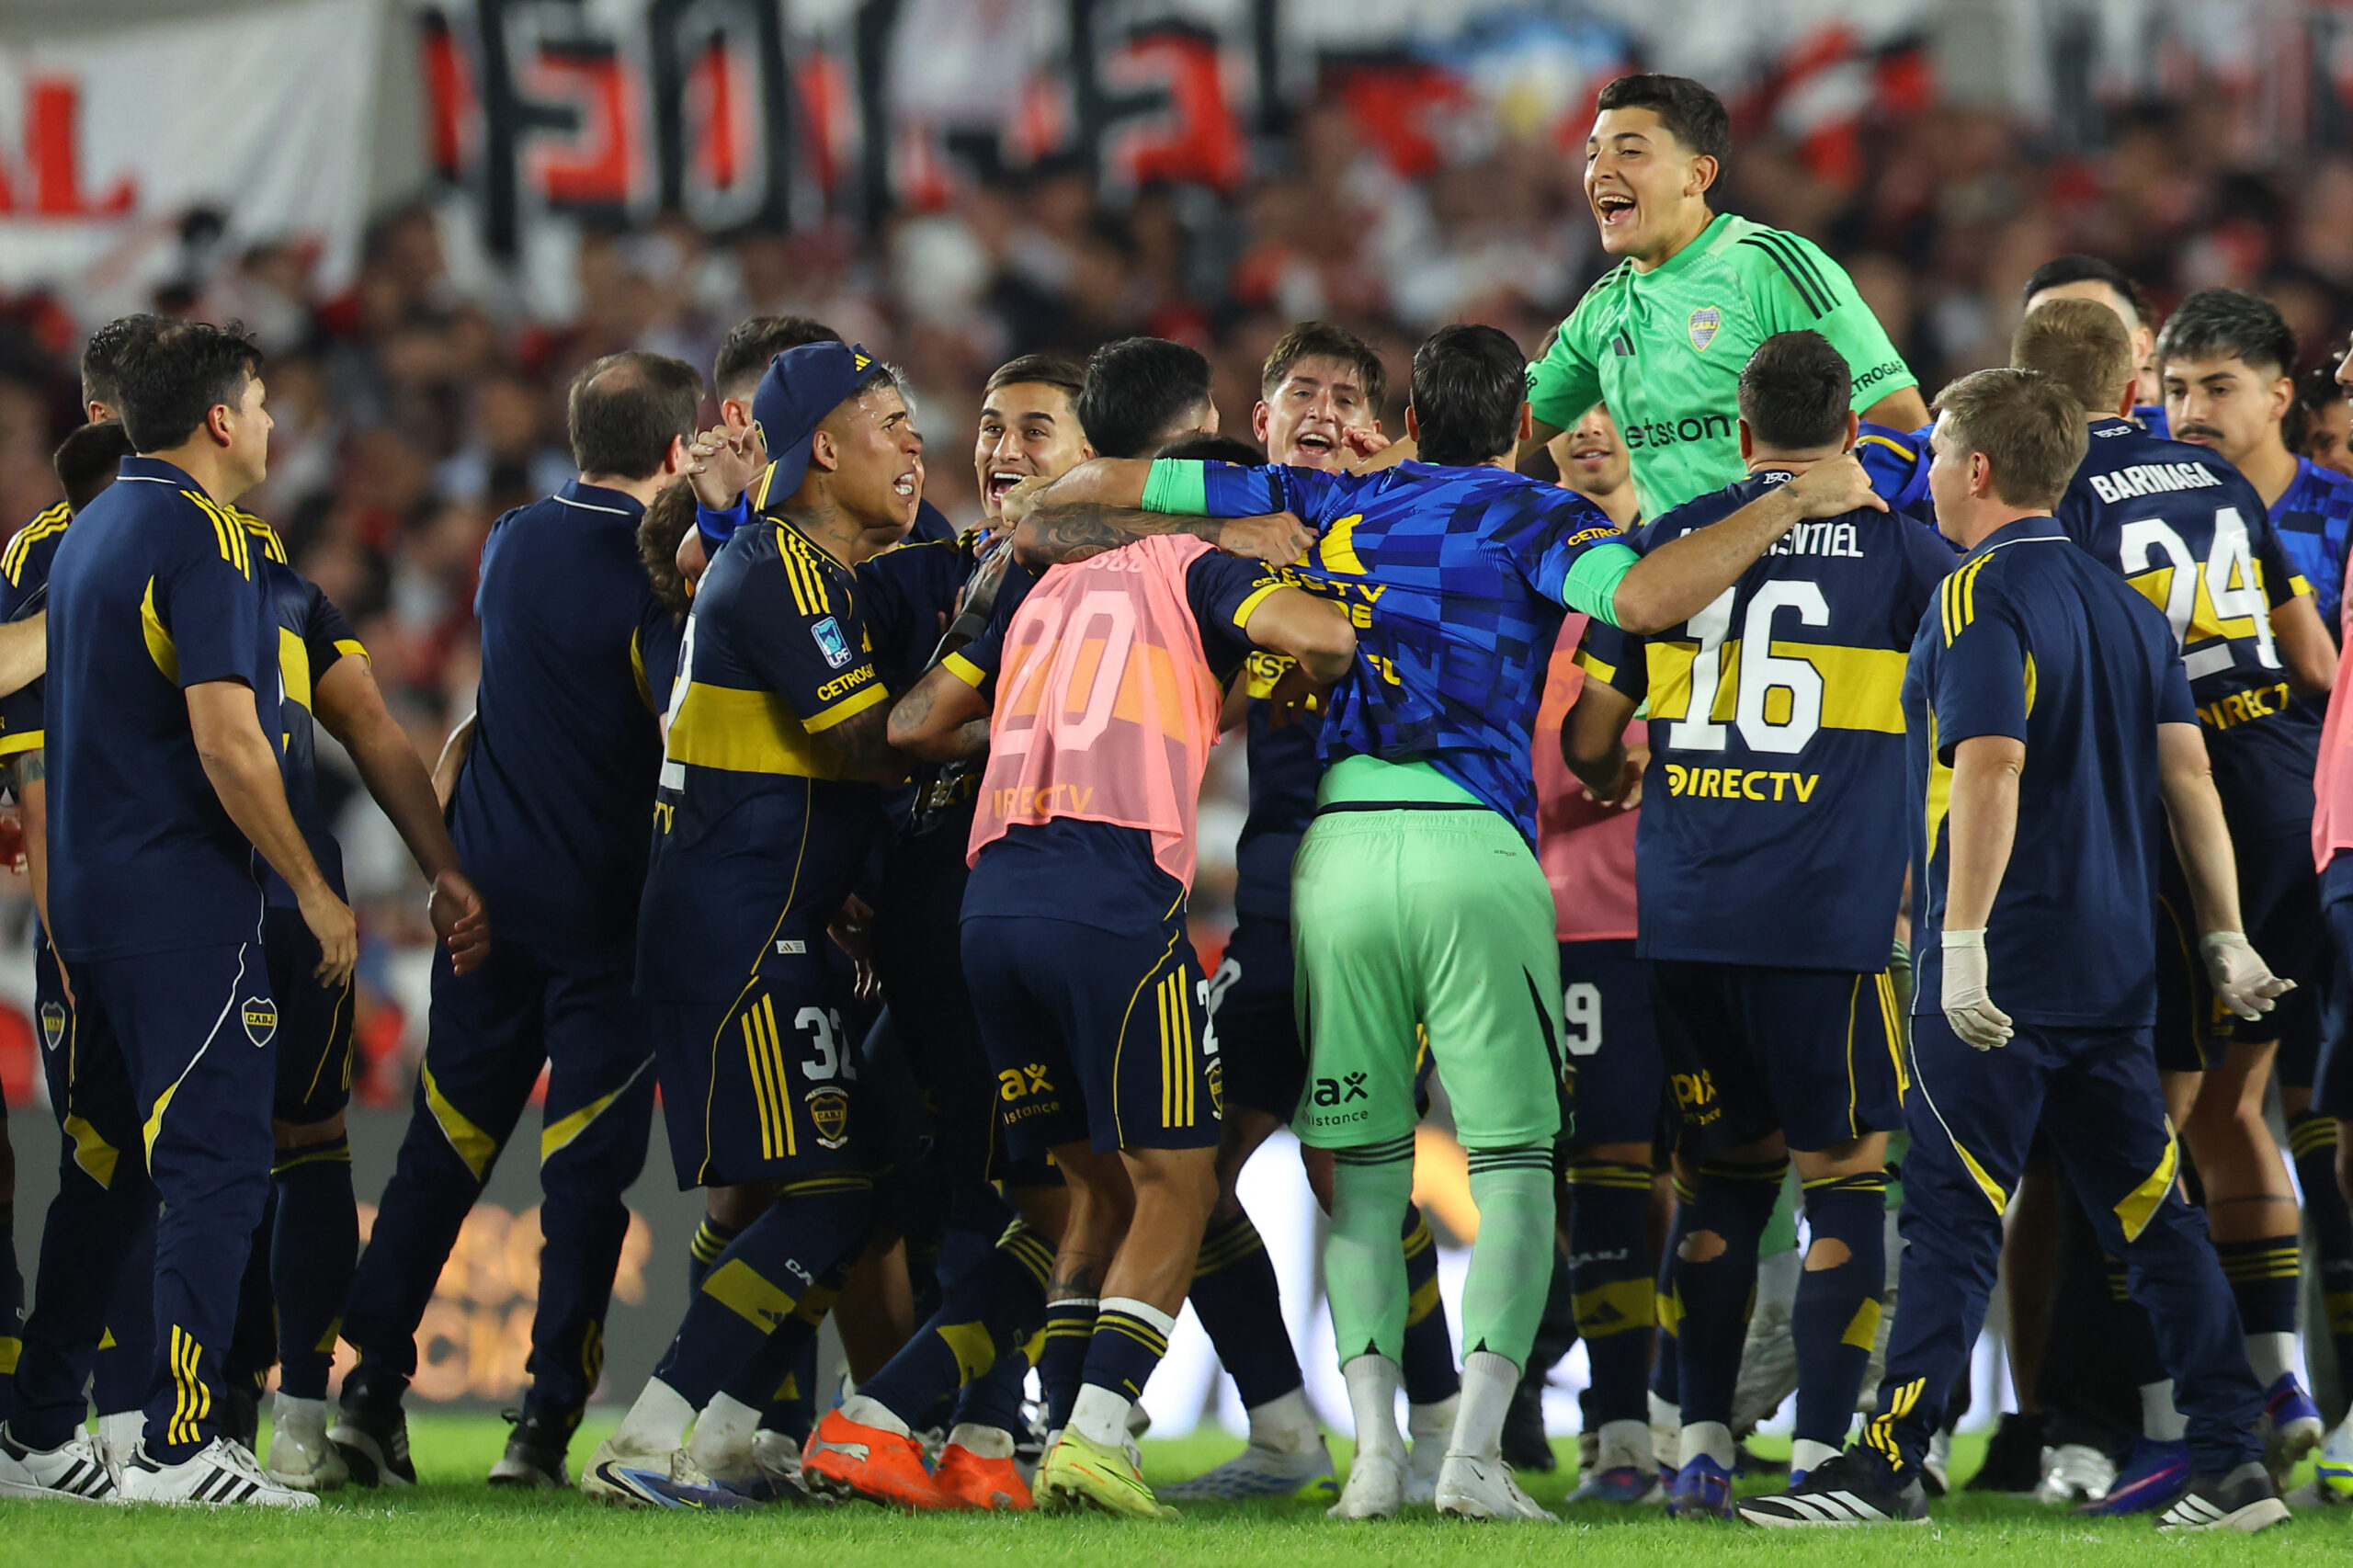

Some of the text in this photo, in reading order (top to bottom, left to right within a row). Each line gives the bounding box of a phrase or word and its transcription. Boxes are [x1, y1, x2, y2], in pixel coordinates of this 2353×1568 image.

[1625, 415, 1731, 449] etsson
[1763, 472, 1797, 484] 190
[2088, 461, 2222, 505] BARINAGA
[1567, 527, 1622, 546] CETRO
[2119, 506, 2284, 681] 24
[828, 647, 849, 666] LPF
[990, 590, 1137, 757] 20
[1668, 579, 1830, 755] 16
[2196, 682, 2289, 730] IRECT
[994, 784, 1094, 819] IRECTV
[1665, 764, 1820, 802] DIRECTV
[247, 1014, 274, 1025] CABJ
[793, 1006, 858, 1081] 32
[998, 1063, 1054, 1101] ax
[1313, 1071, 1369, 1107] ax
